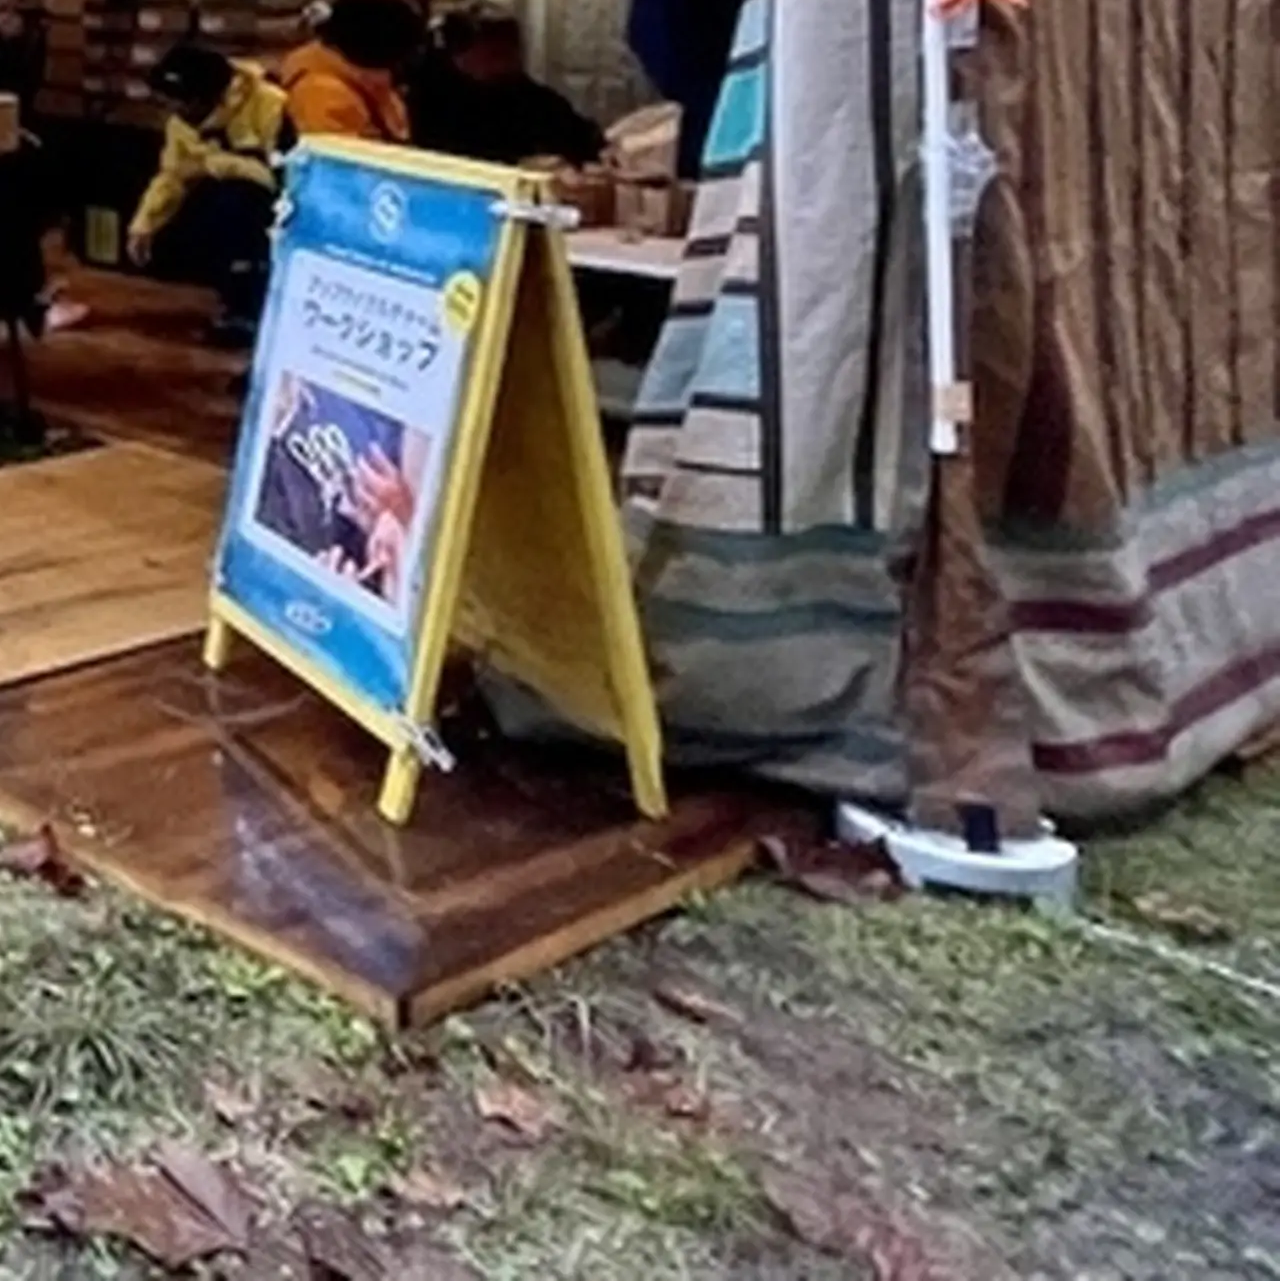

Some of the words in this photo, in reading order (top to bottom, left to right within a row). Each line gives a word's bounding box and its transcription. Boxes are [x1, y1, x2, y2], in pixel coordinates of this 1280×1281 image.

[302, 298, 441, 372] ワークショップ
